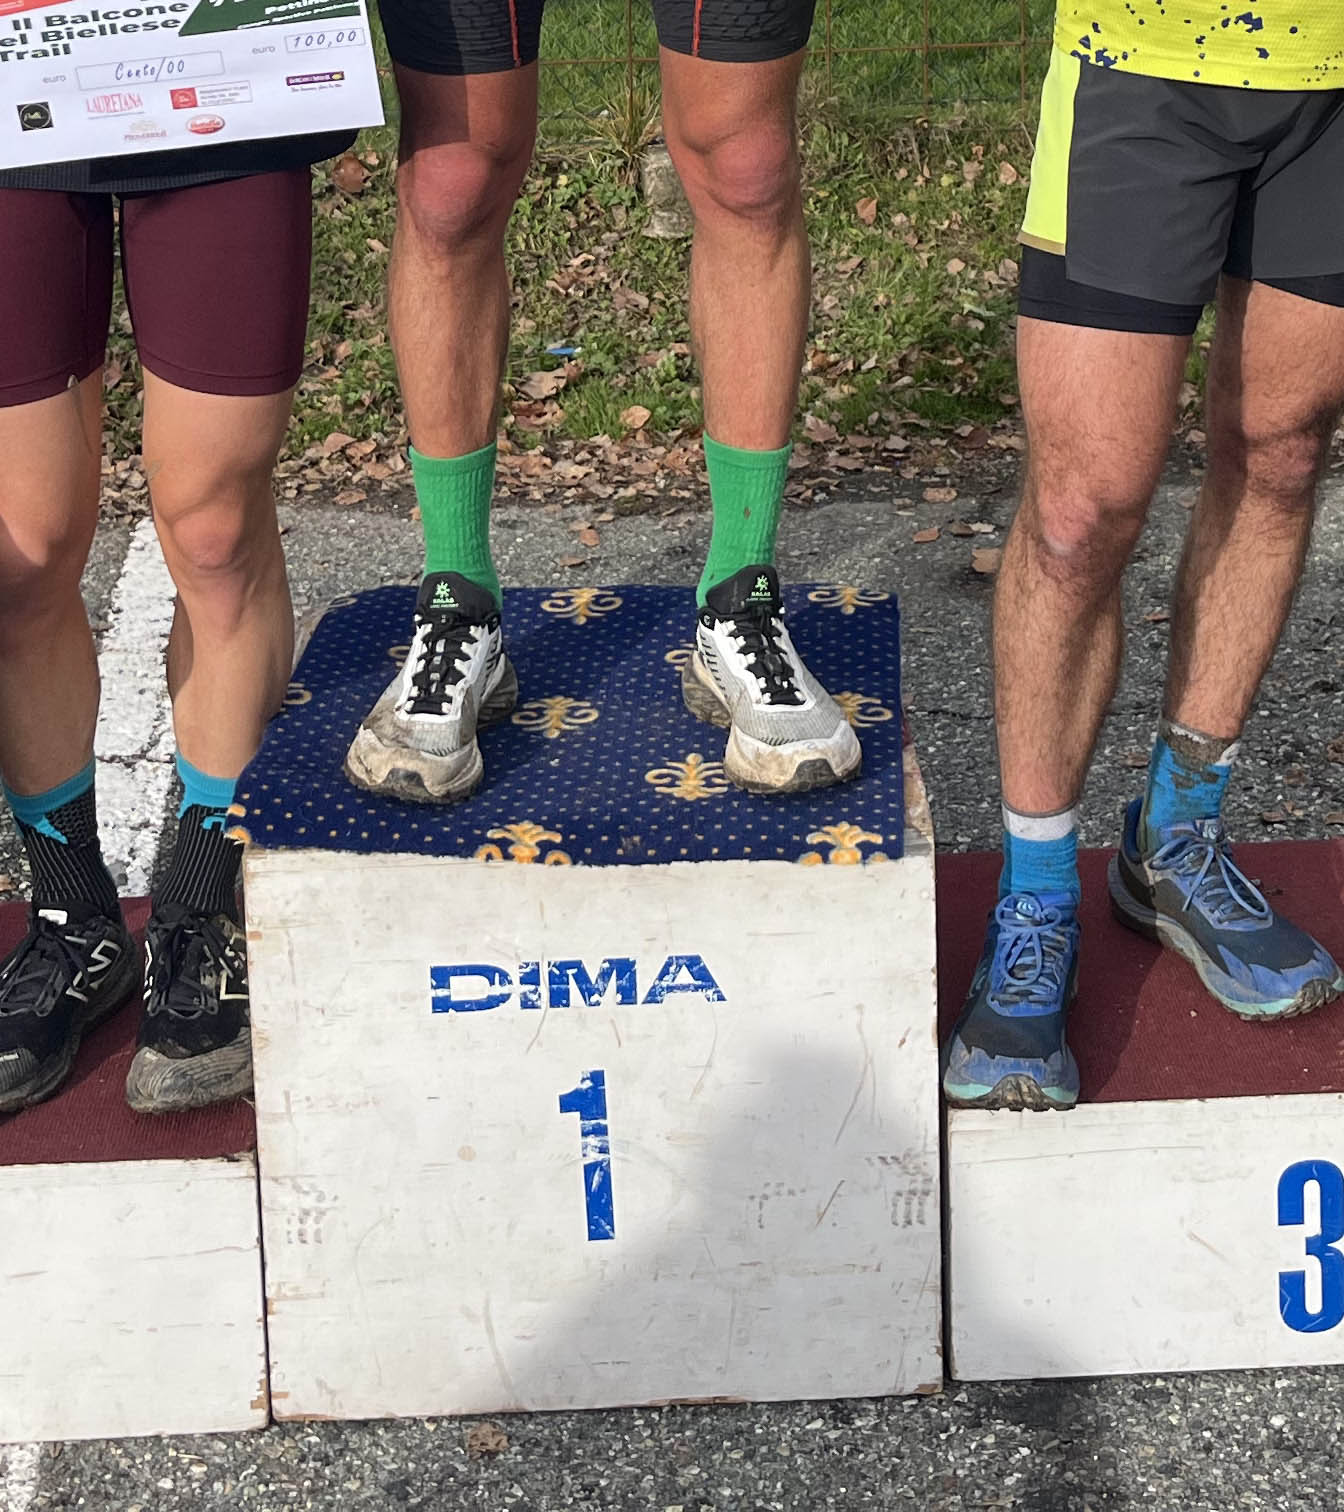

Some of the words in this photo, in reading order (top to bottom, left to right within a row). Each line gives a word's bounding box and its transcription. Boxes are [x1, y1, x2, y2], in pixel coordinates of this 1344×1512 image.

[12, 18, 32, 31] Il
[45, 2, 189, 27] Balcone
[42, 18, 181, 43] Biellese
[43, 75, 66, 84] euro
[115, 57, 185, 82] Cento/00
[252, 46, 275, 54] euro
[294, 30, 357, 48] 100,00
[86, 93, 143, 113] LAURETANA
[429, 954, 727, 1014] DIMA
[558, 1069, 616, 1242] 1
